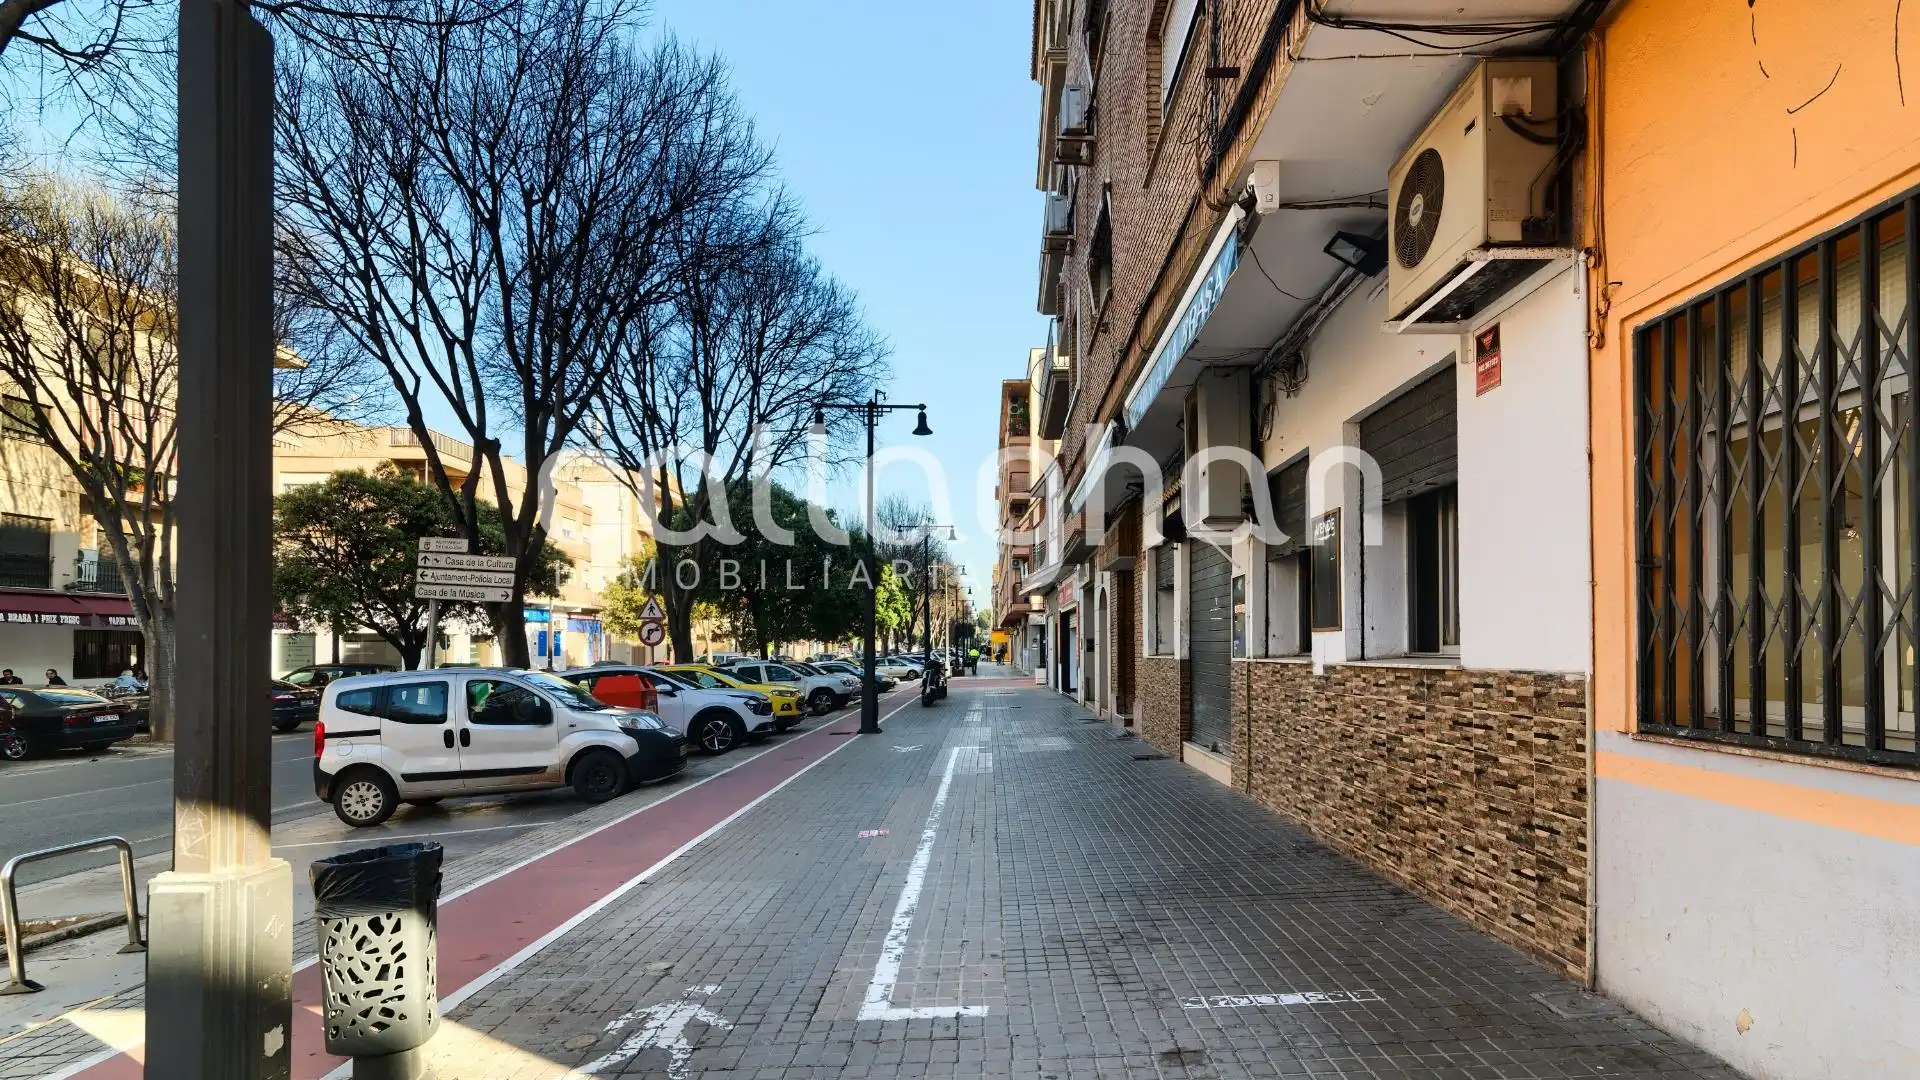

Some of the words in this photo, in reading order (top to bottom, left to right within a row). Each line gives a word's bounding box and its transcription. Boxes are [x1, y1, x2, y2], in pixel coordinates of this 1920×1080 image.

[445, 557, 464, 566] Casa
[466, 558, 476, 567] de
[477, 559, 485, 567] la
[486, 560, 514, 569] Cultura
[494, 576, 513, 585] Local
[417, 587, 437, 597] Casa
[438, 589, 448, 597] de
[450, 589, 457, 598] la
[458, 589, 486, 599] Música
[7, 612, 33, 623] BRASA
